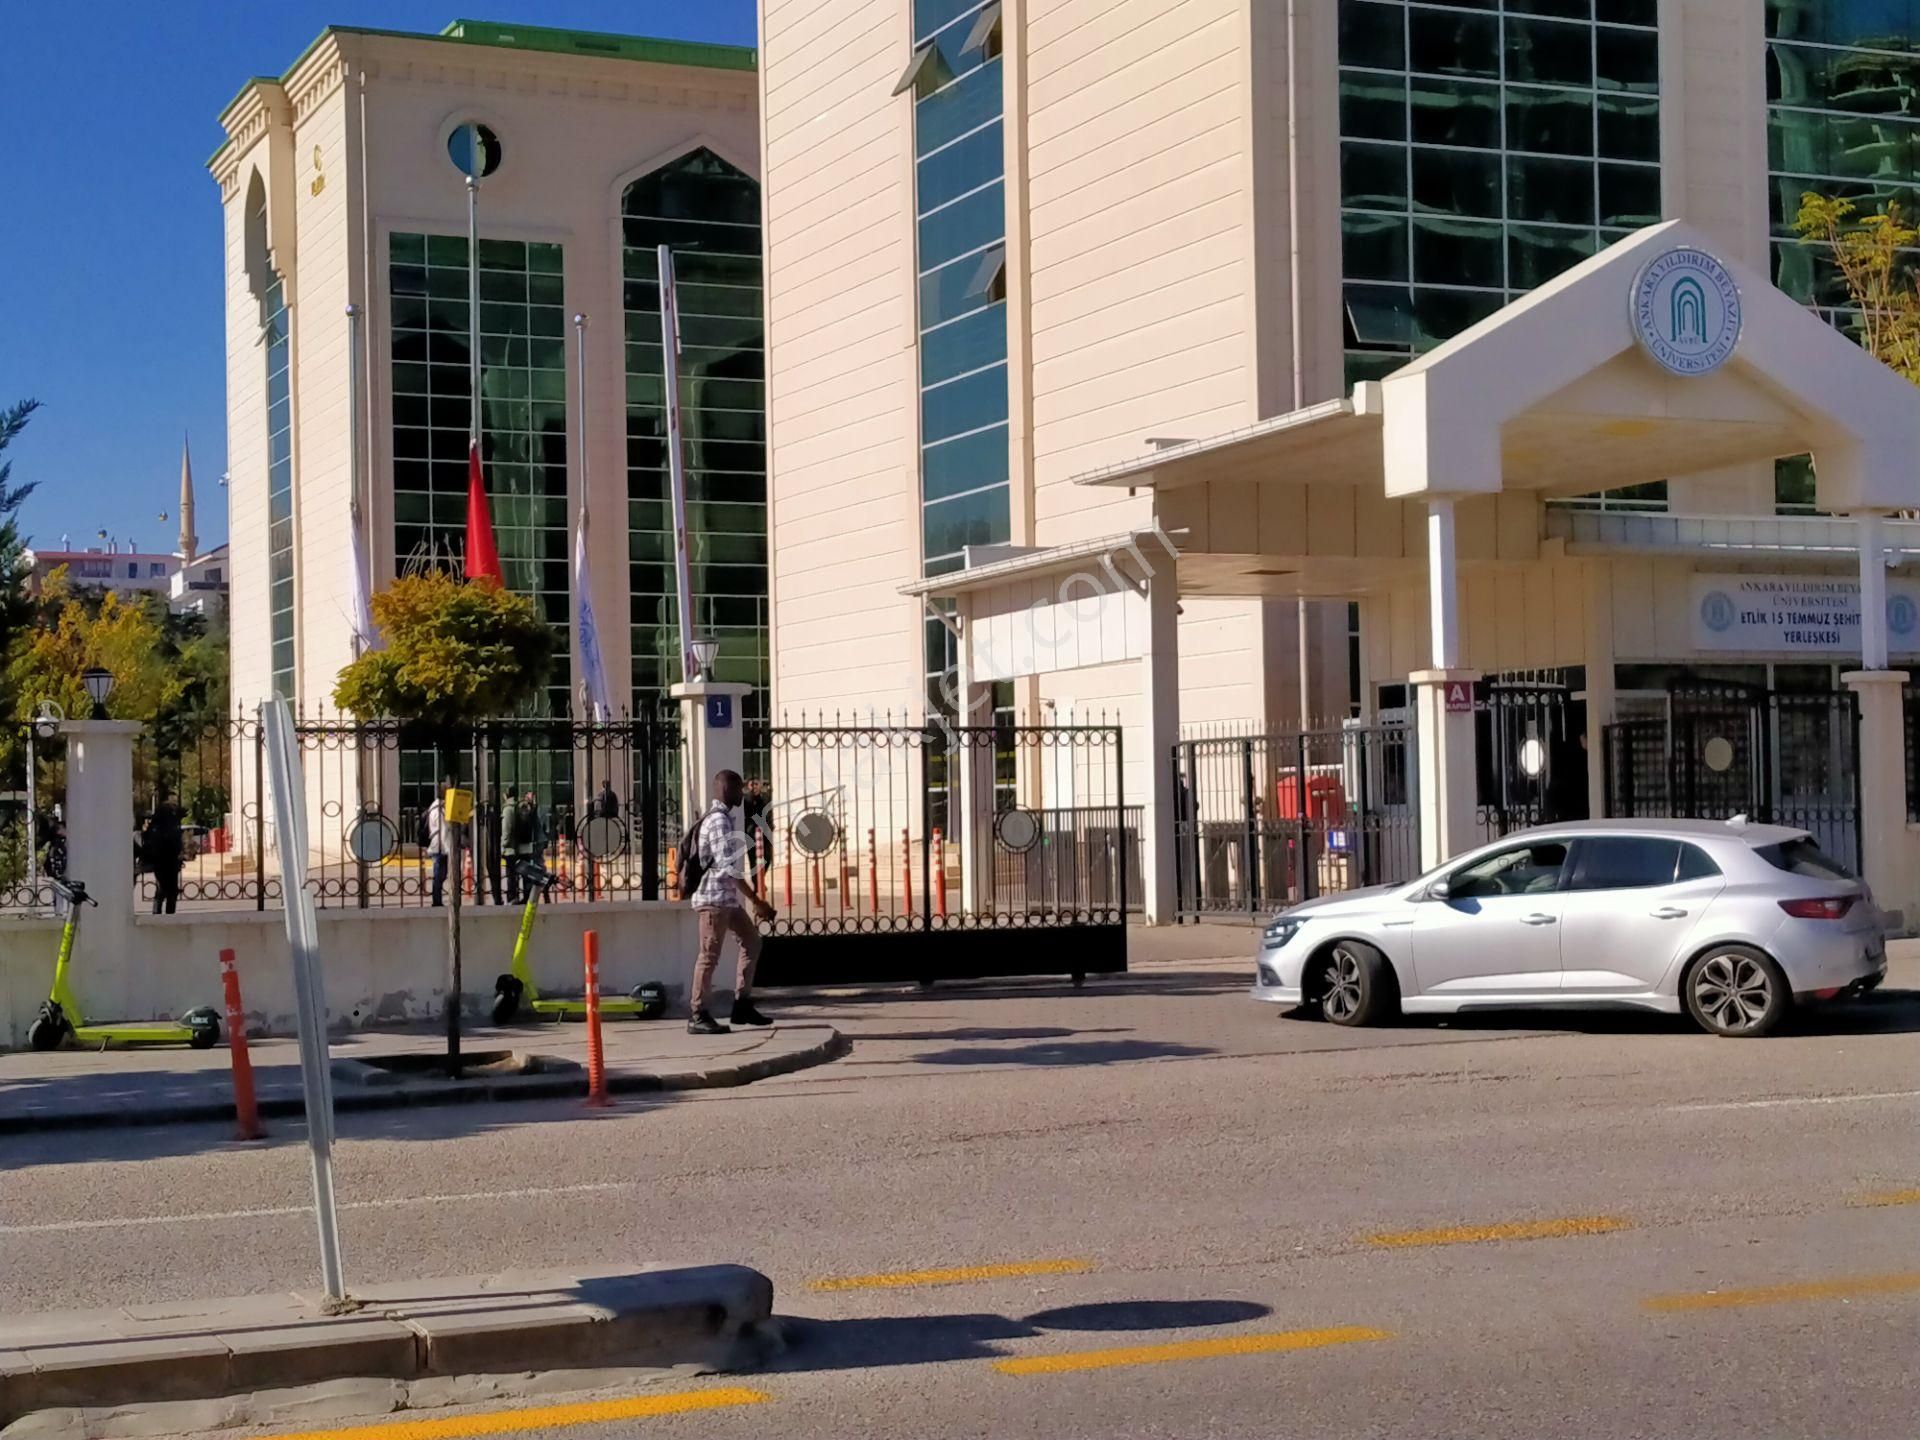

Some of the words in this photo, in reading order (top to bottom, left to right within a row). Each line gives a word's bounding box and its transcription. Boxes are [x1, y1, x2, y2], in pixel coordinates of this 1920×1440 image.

[1640, 271, 1661, 330] ANKARA
[1657, 252, 1716, 274] YILDIRIM
[1714, 271, 1737, 332] BEYAZIT
[1741, 608, 1768, 625] ETLİK
[1771, 611, 1784, 625] 15
[1786, 611, 1831, 625] TEMMUZ
[1783, 630, 1841, 645] YERLEŞKESİ
[1450, 684, 1466, 701] A
[716, 701, 724, 717] 1
